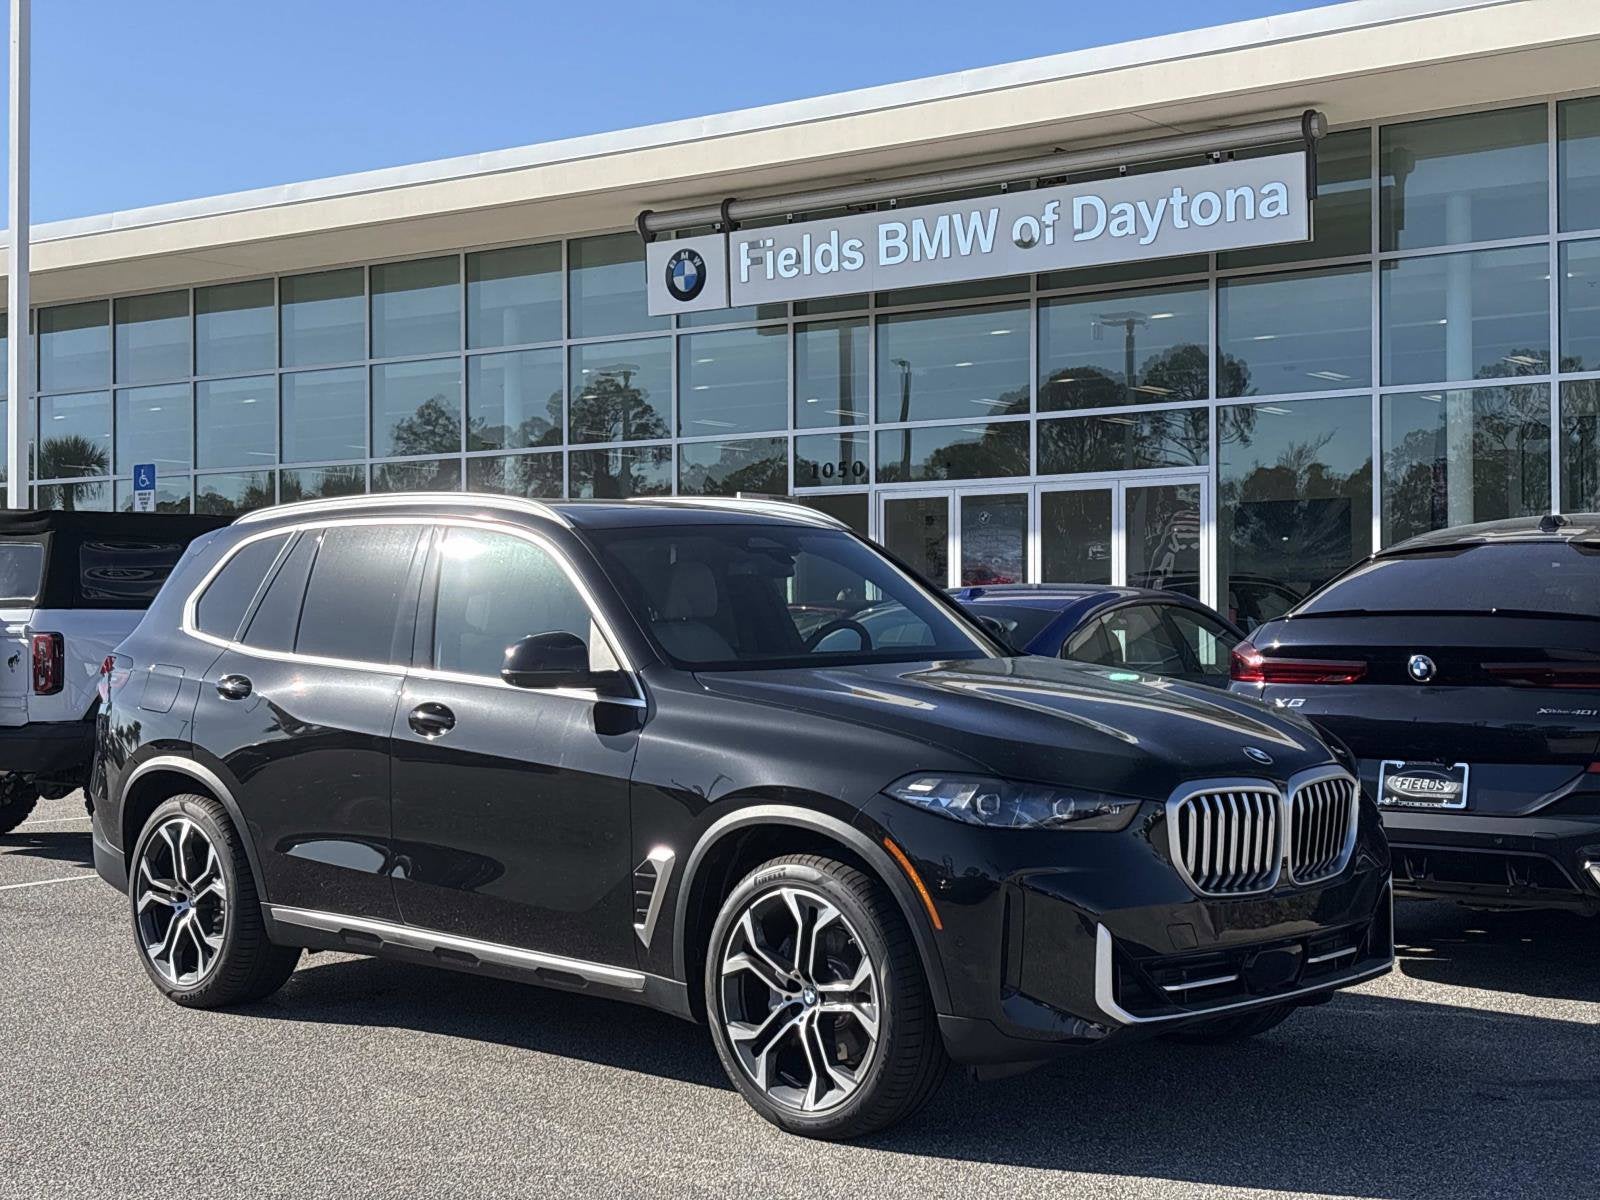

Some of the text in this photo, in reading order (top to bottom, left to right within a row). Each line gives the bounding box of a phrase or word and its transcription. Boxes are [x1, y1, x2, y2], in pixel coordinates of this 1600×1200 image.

[739, 181, 1289, 284] Fields BMW of Daytona
[810, 460, 866, 479] 1050
[1400, 778, 1445, 791] FIELDS
